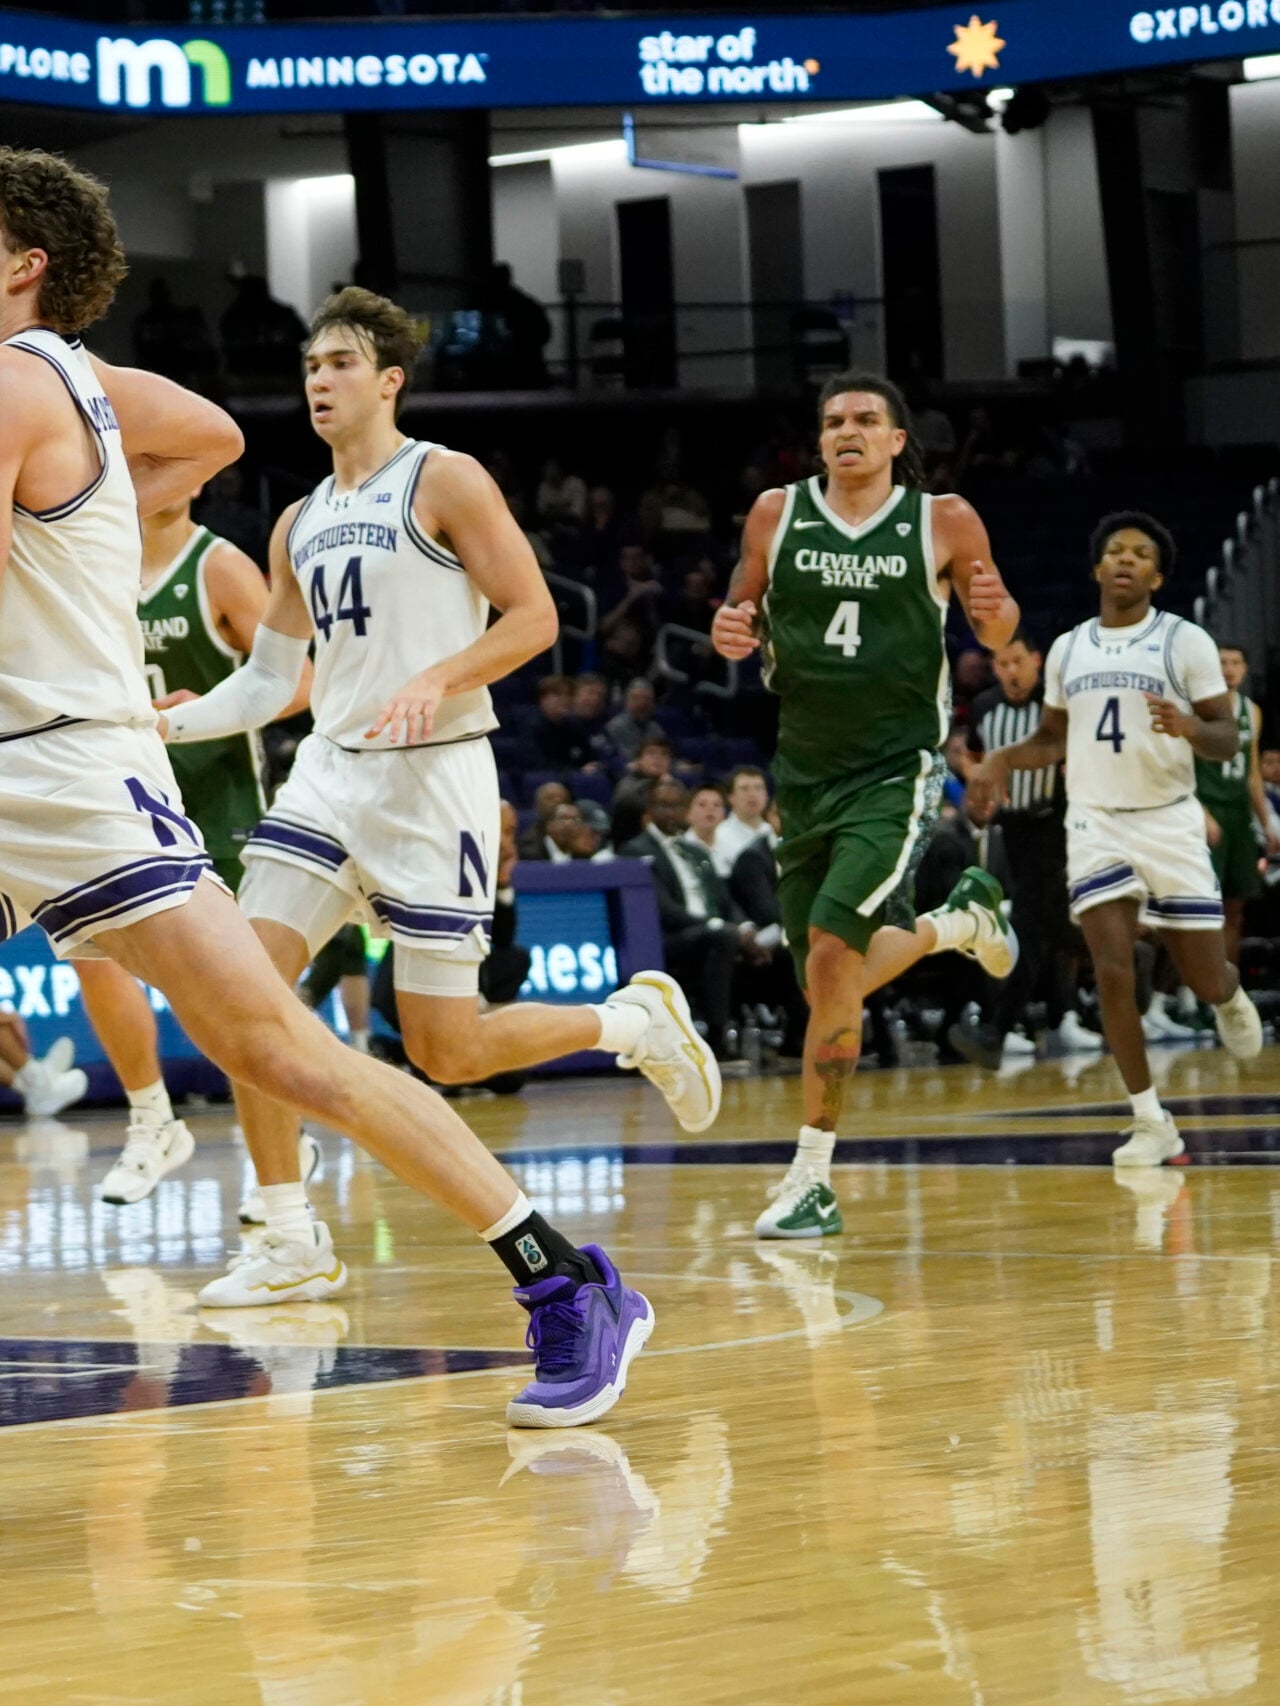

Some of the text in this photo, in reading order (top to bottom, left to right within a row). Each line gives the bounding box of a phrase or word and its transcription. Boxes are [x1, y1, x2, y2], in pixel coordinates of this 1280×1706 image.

[638, 26, 757, 63] star of
[639, 57, 810, 94] the north
[294, 522, 398, 573] NORTHWESTERN
[794, 548, 908, 578] CLEVELAND
[311, 556, 372, 643] 44
[821, 569, 875, 589] STATE
[823, 600, 862, 657] 4
[1096, 696, 1125, 753] 4
